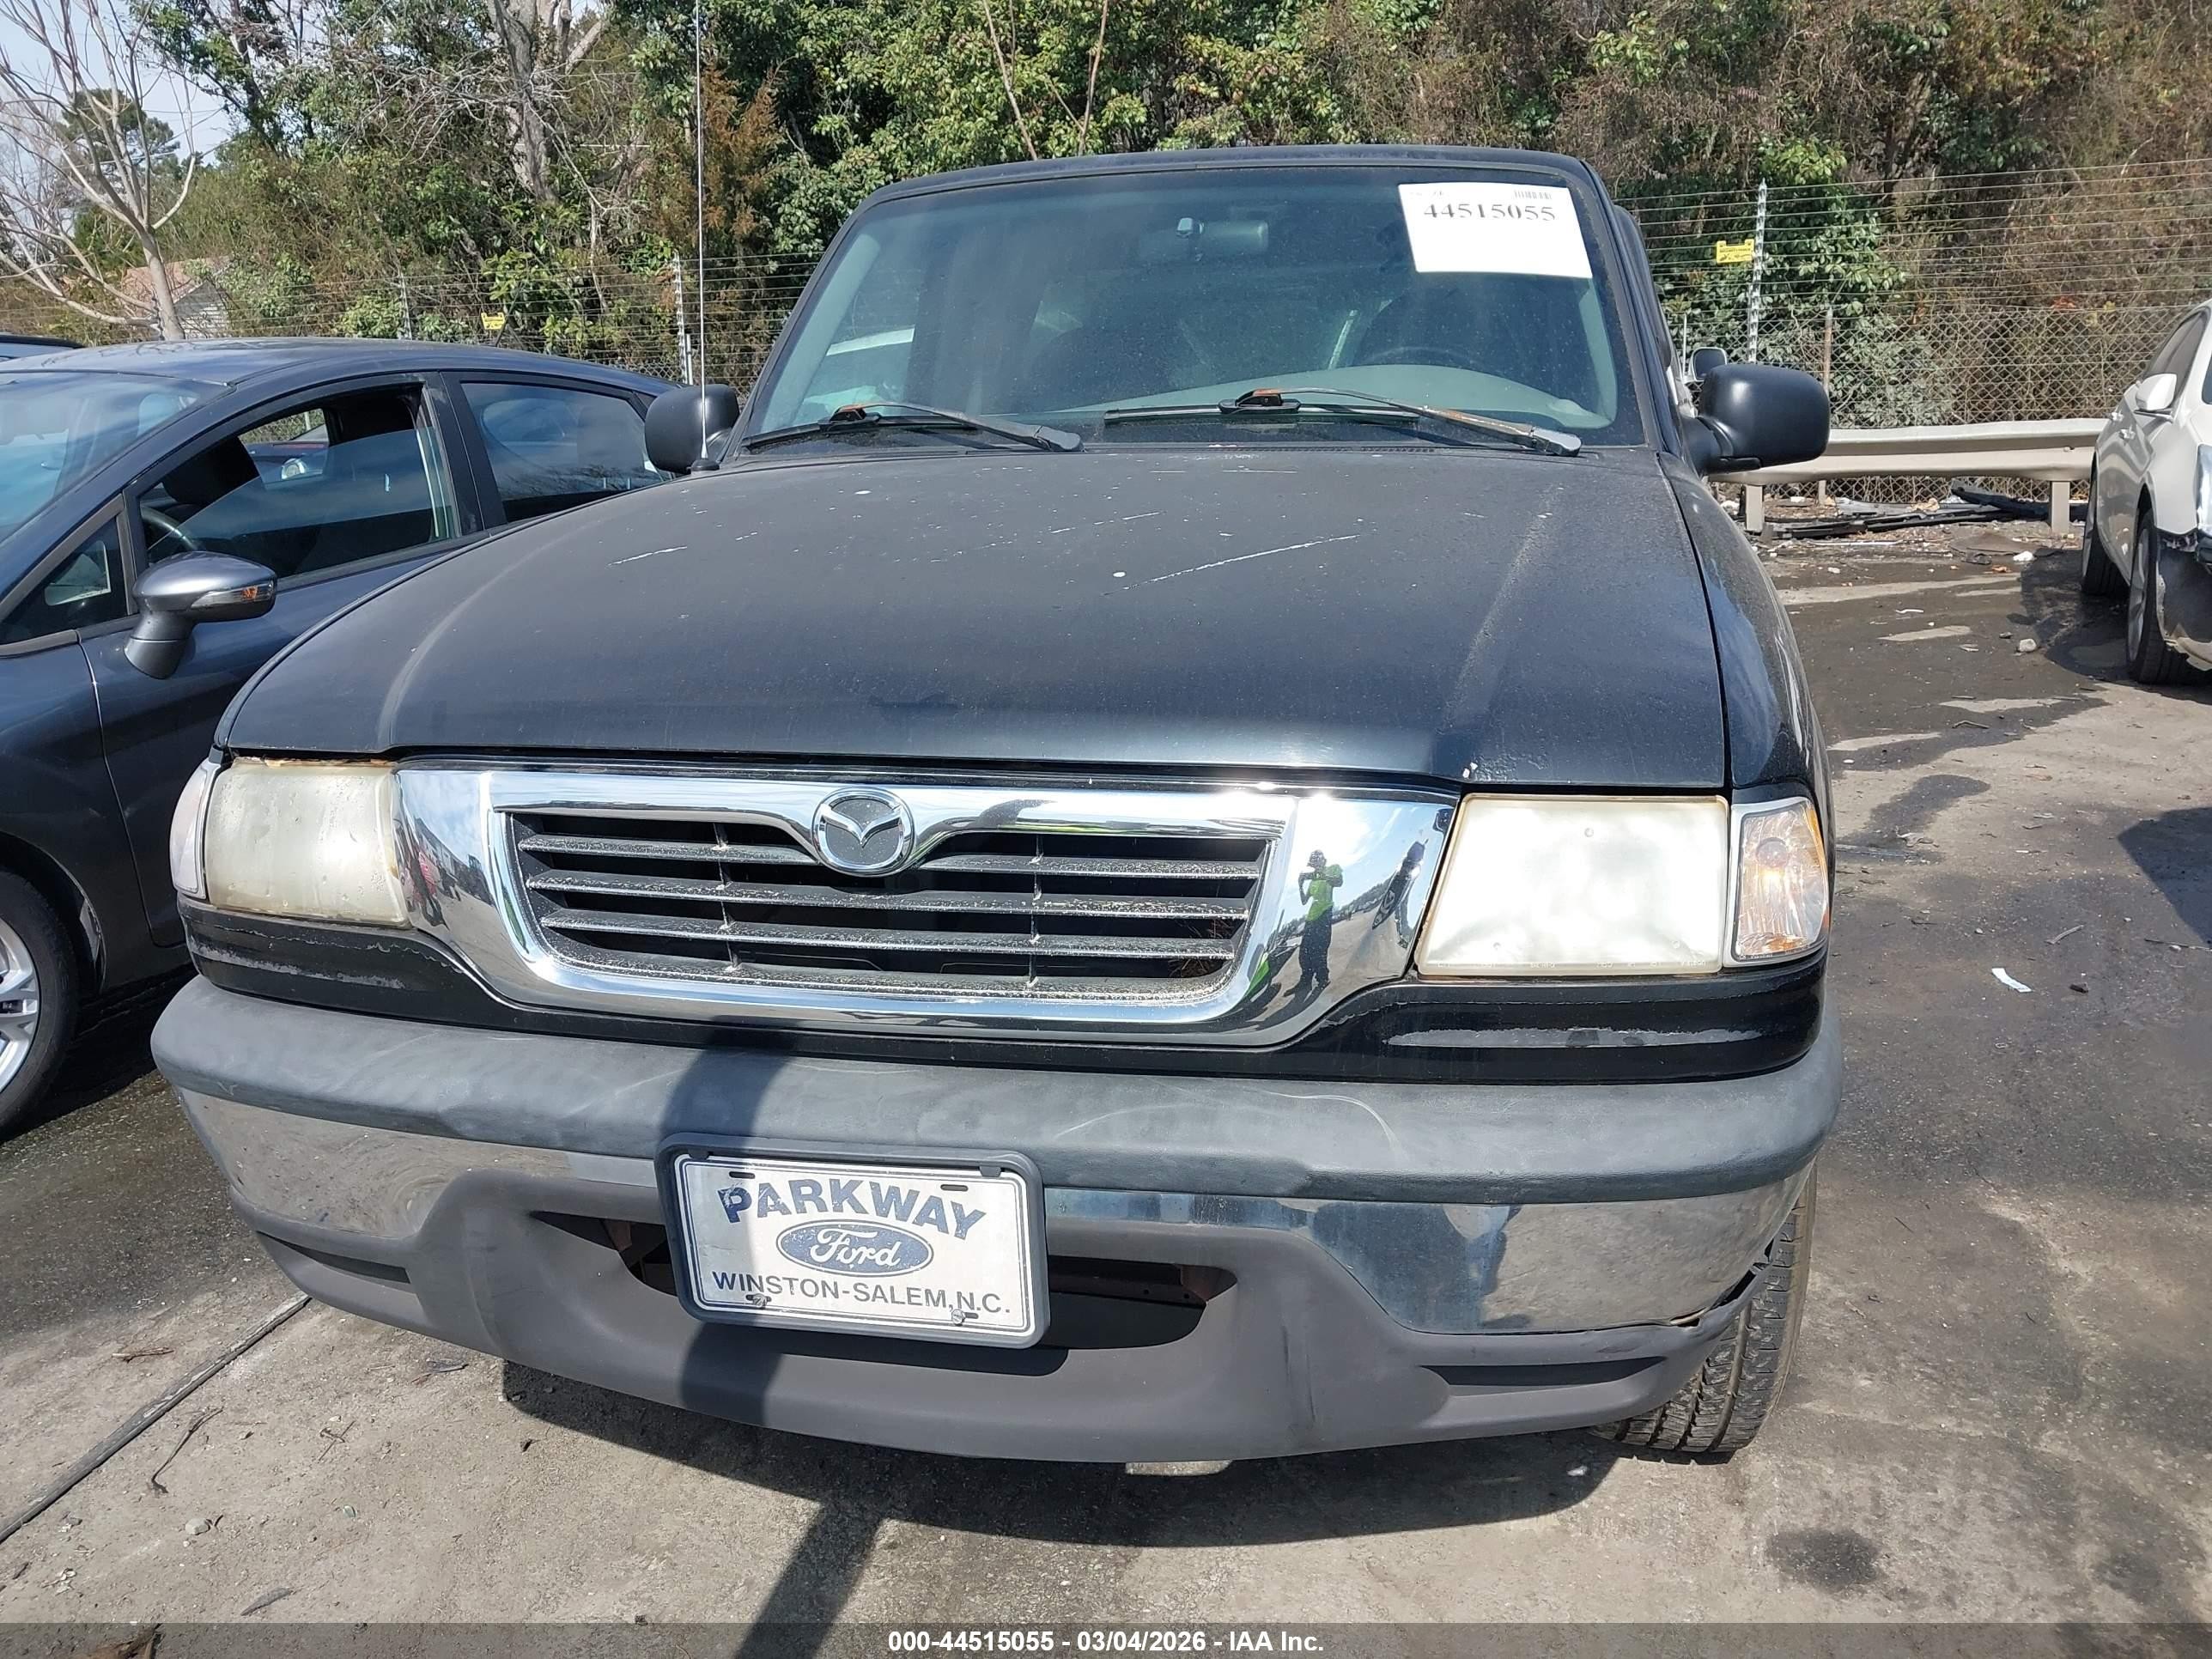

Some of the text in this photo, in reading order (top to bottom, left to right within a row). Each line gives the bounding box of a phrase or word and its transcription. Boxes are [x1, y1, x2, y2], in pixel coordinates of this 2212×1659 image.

[1423, 204, 1556, 222] 44515055
[717, 1178, 987, 1241] PARKWAY
[810, 1228, 902, 1267] Ford
